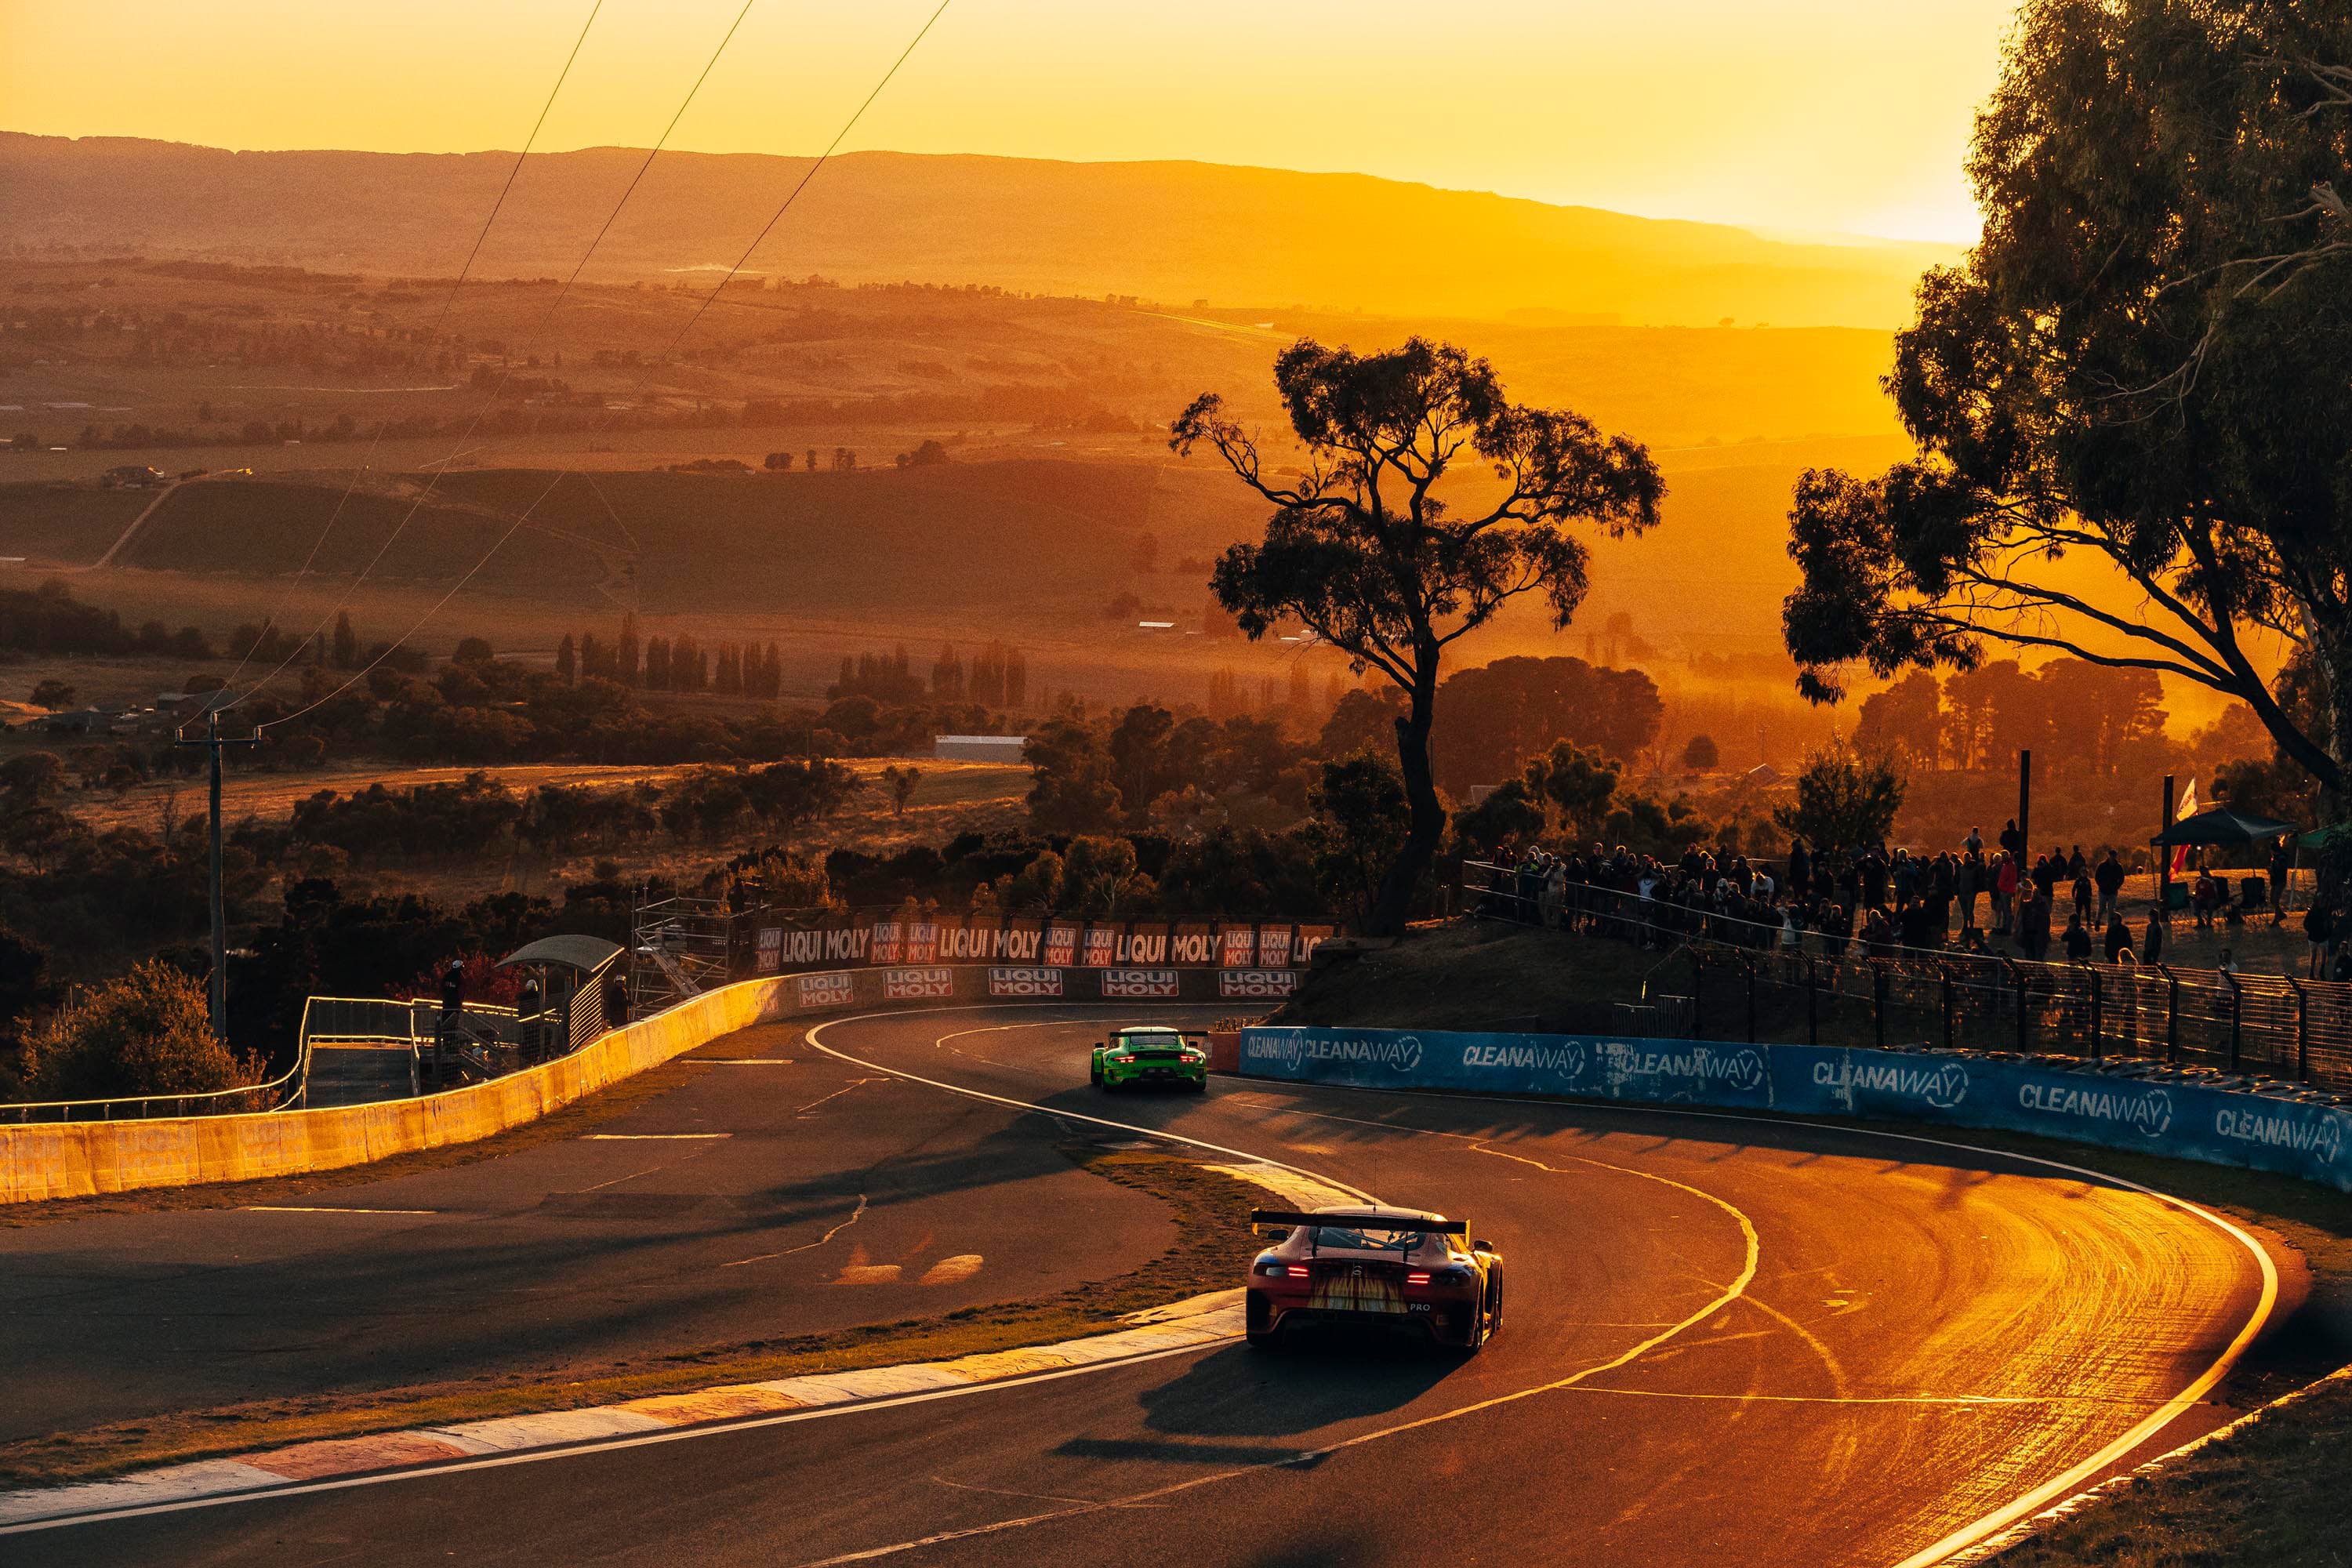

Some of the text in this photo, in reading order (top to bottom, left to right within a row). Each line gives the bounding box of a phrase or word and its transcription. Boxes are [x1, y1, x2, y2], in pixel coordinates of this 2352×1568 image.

[874, 925, 899, 942] LIQUI
[909, 926, 936, 942] LIQUI
[1047, 930, 1074, 946] LIQUI
[1084, 931, 1112, 947] LIQUI
[1227, 933, 1254, 948] LIQUI
[1261, 934, 1290, 949] LIQUI
[782, 928, 870, 964] LIQUI MOLY
[873, 942, 898, 960] MOLY
[940, 928, 1042, 959] LIQUI MOLY
[1116, 934, 1222, 964] LIQUI MOLY
[908, 944, 935, 960] MOLY
[1044, 947, 1073, 964] MOLY
[1083, 949, 1111, 964] MOLY
[1225, 950, 1254, 965] MOLY
[1260, 950, 1289, 965] MOLY
[800, 976, 848, 991] LIQUI
[887, 971, 948, 983] LIQUI
[993, 970, 1058, 982] LIQUI
[1105, 971, 1174, 983] LIQUI
[1224, 972, 1291, 984] LIQUI
[888, 983, 950, 996] MOLY
[994, 982, 1060, 993] MOLY
[1106, 983, 1175, 994] MOLY
[1224, 984, 1294, 995] MOLY
[801, 989, 850, 1004] MOLY
[1248, 1036, 1300, 1062] CLEANAWAY
[1305, 1040, 1415, 1063] CLEANAWAY
[1463, 1045, 1579, 1069] CLEANAWAY
[1622, 1053, 1753, 1080] CLEANAWAY
[2019, 1083, 2164, 1126] CLEANAWAY
[2216, 1109, 2335, 1151] CLEANAWAY
[121, 1152, 194, 1178] MOLY
[1410, 1303, 1432, 1312] PRO
